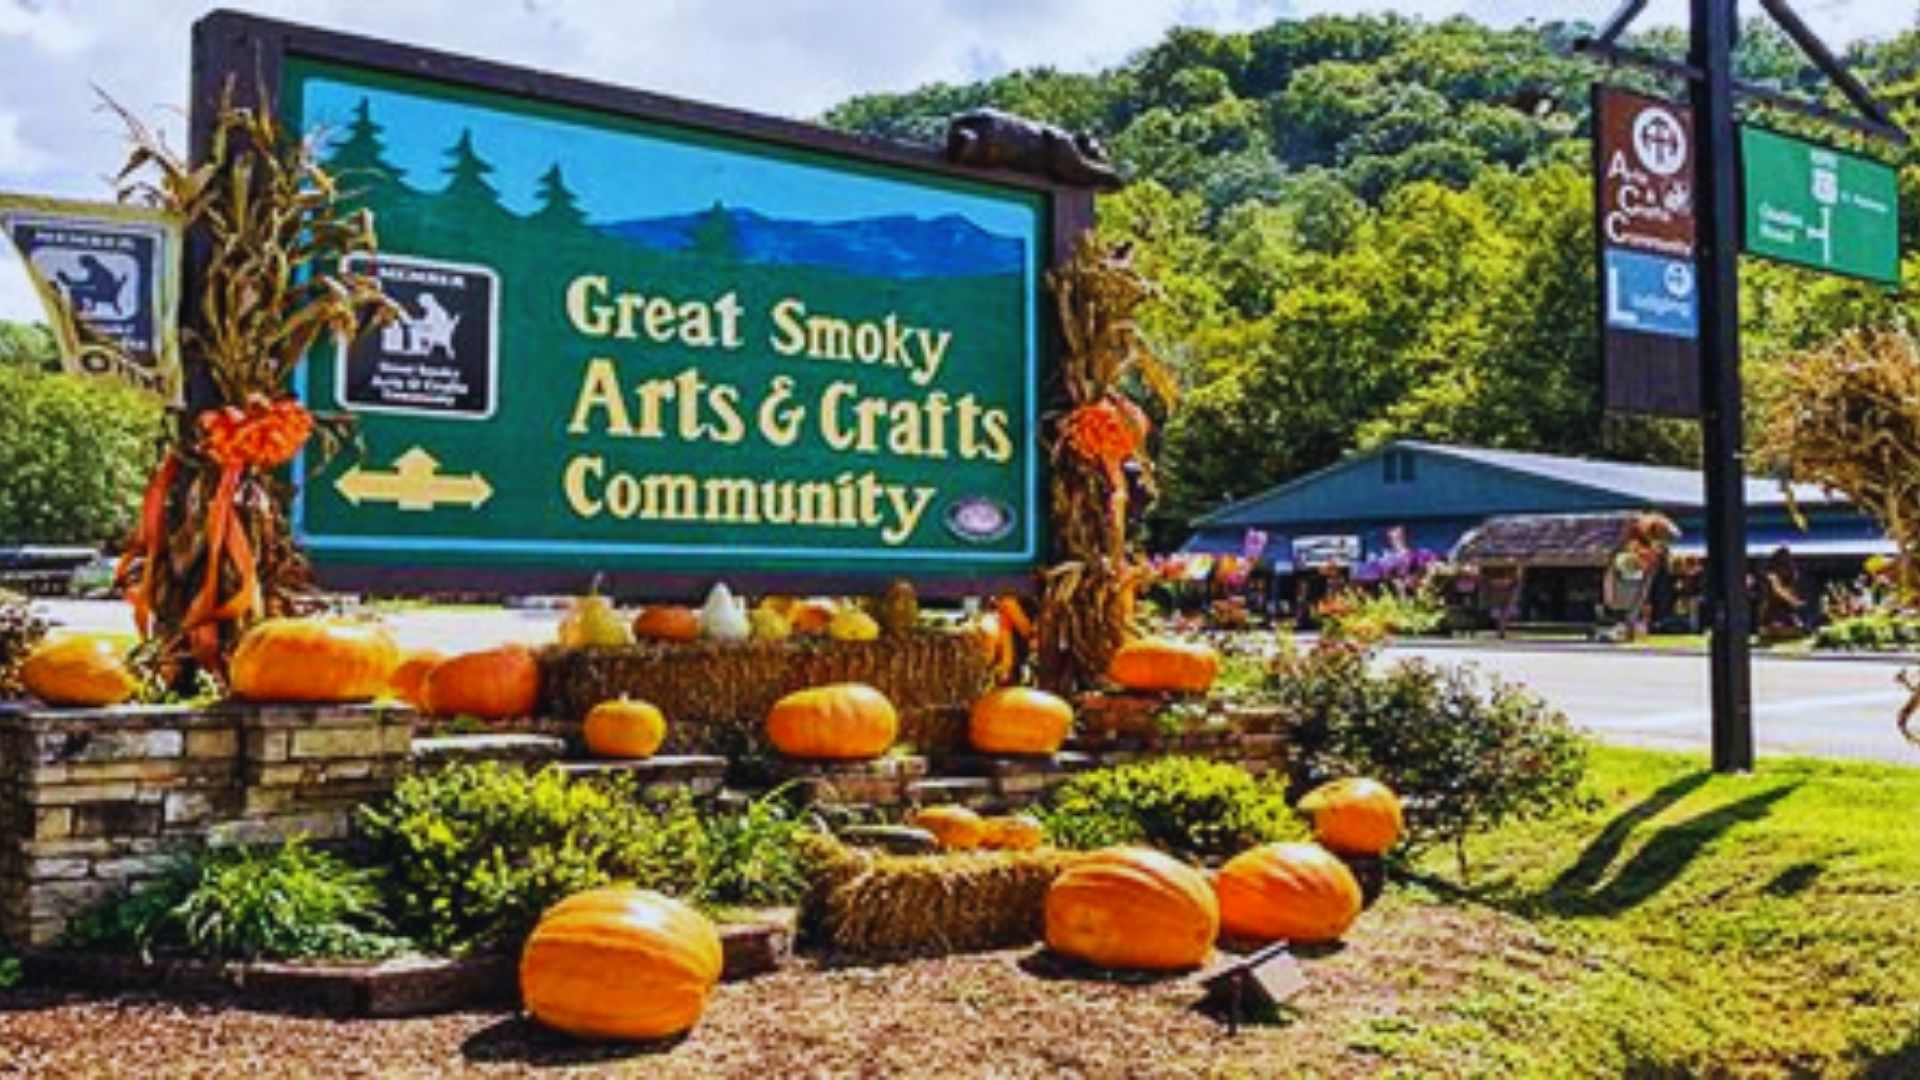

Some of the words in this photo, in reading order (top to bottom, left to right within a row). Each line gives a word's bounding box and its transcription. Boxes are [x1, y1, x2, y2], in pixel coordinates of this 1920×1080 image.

[379, 267, 464, 287] MEMBER
[566, 275, 745, 348] Great
[770, 298, 952, 385] Smoky
[567, 357, 745, 444] Arts
[758, 375, 806, 446] &
[820, 382, 1013, 462] Crafts
[563, 455, 938, 544] Community
